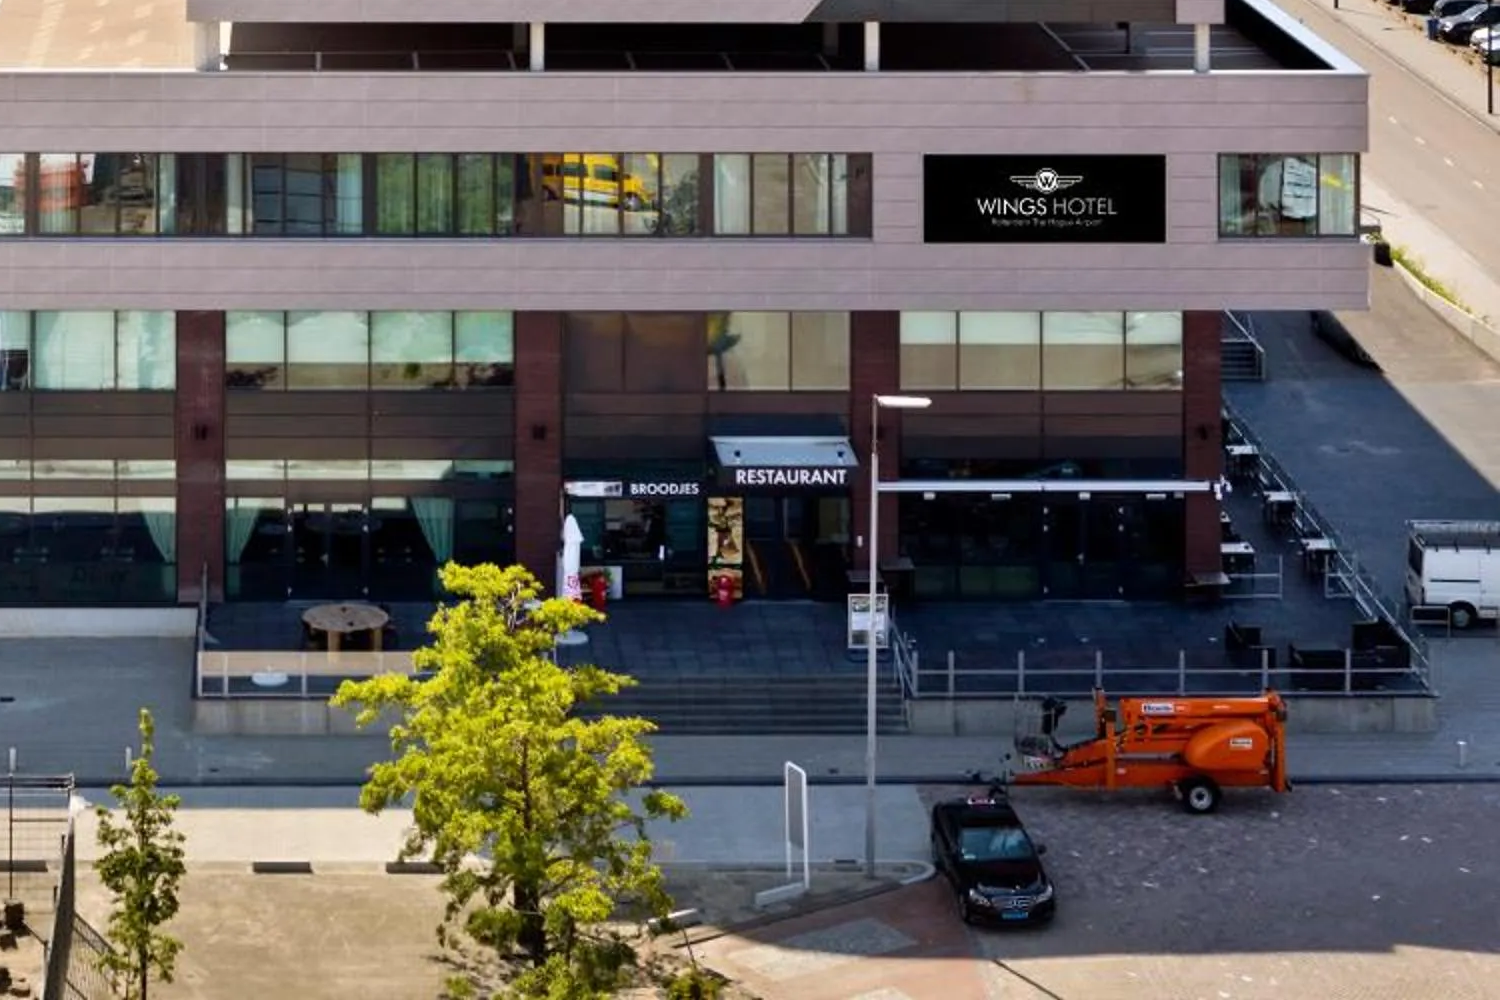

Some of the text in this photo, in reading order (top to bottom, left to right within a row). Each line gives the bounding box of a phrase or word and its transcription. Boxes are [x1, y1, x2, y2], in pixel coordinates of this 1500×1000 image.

[976, 198, 1118, 215] WINGS HOTEL
[735, 468, 847, 485] RESTAURANT
[630, 482, 699, 495] BROODJES
